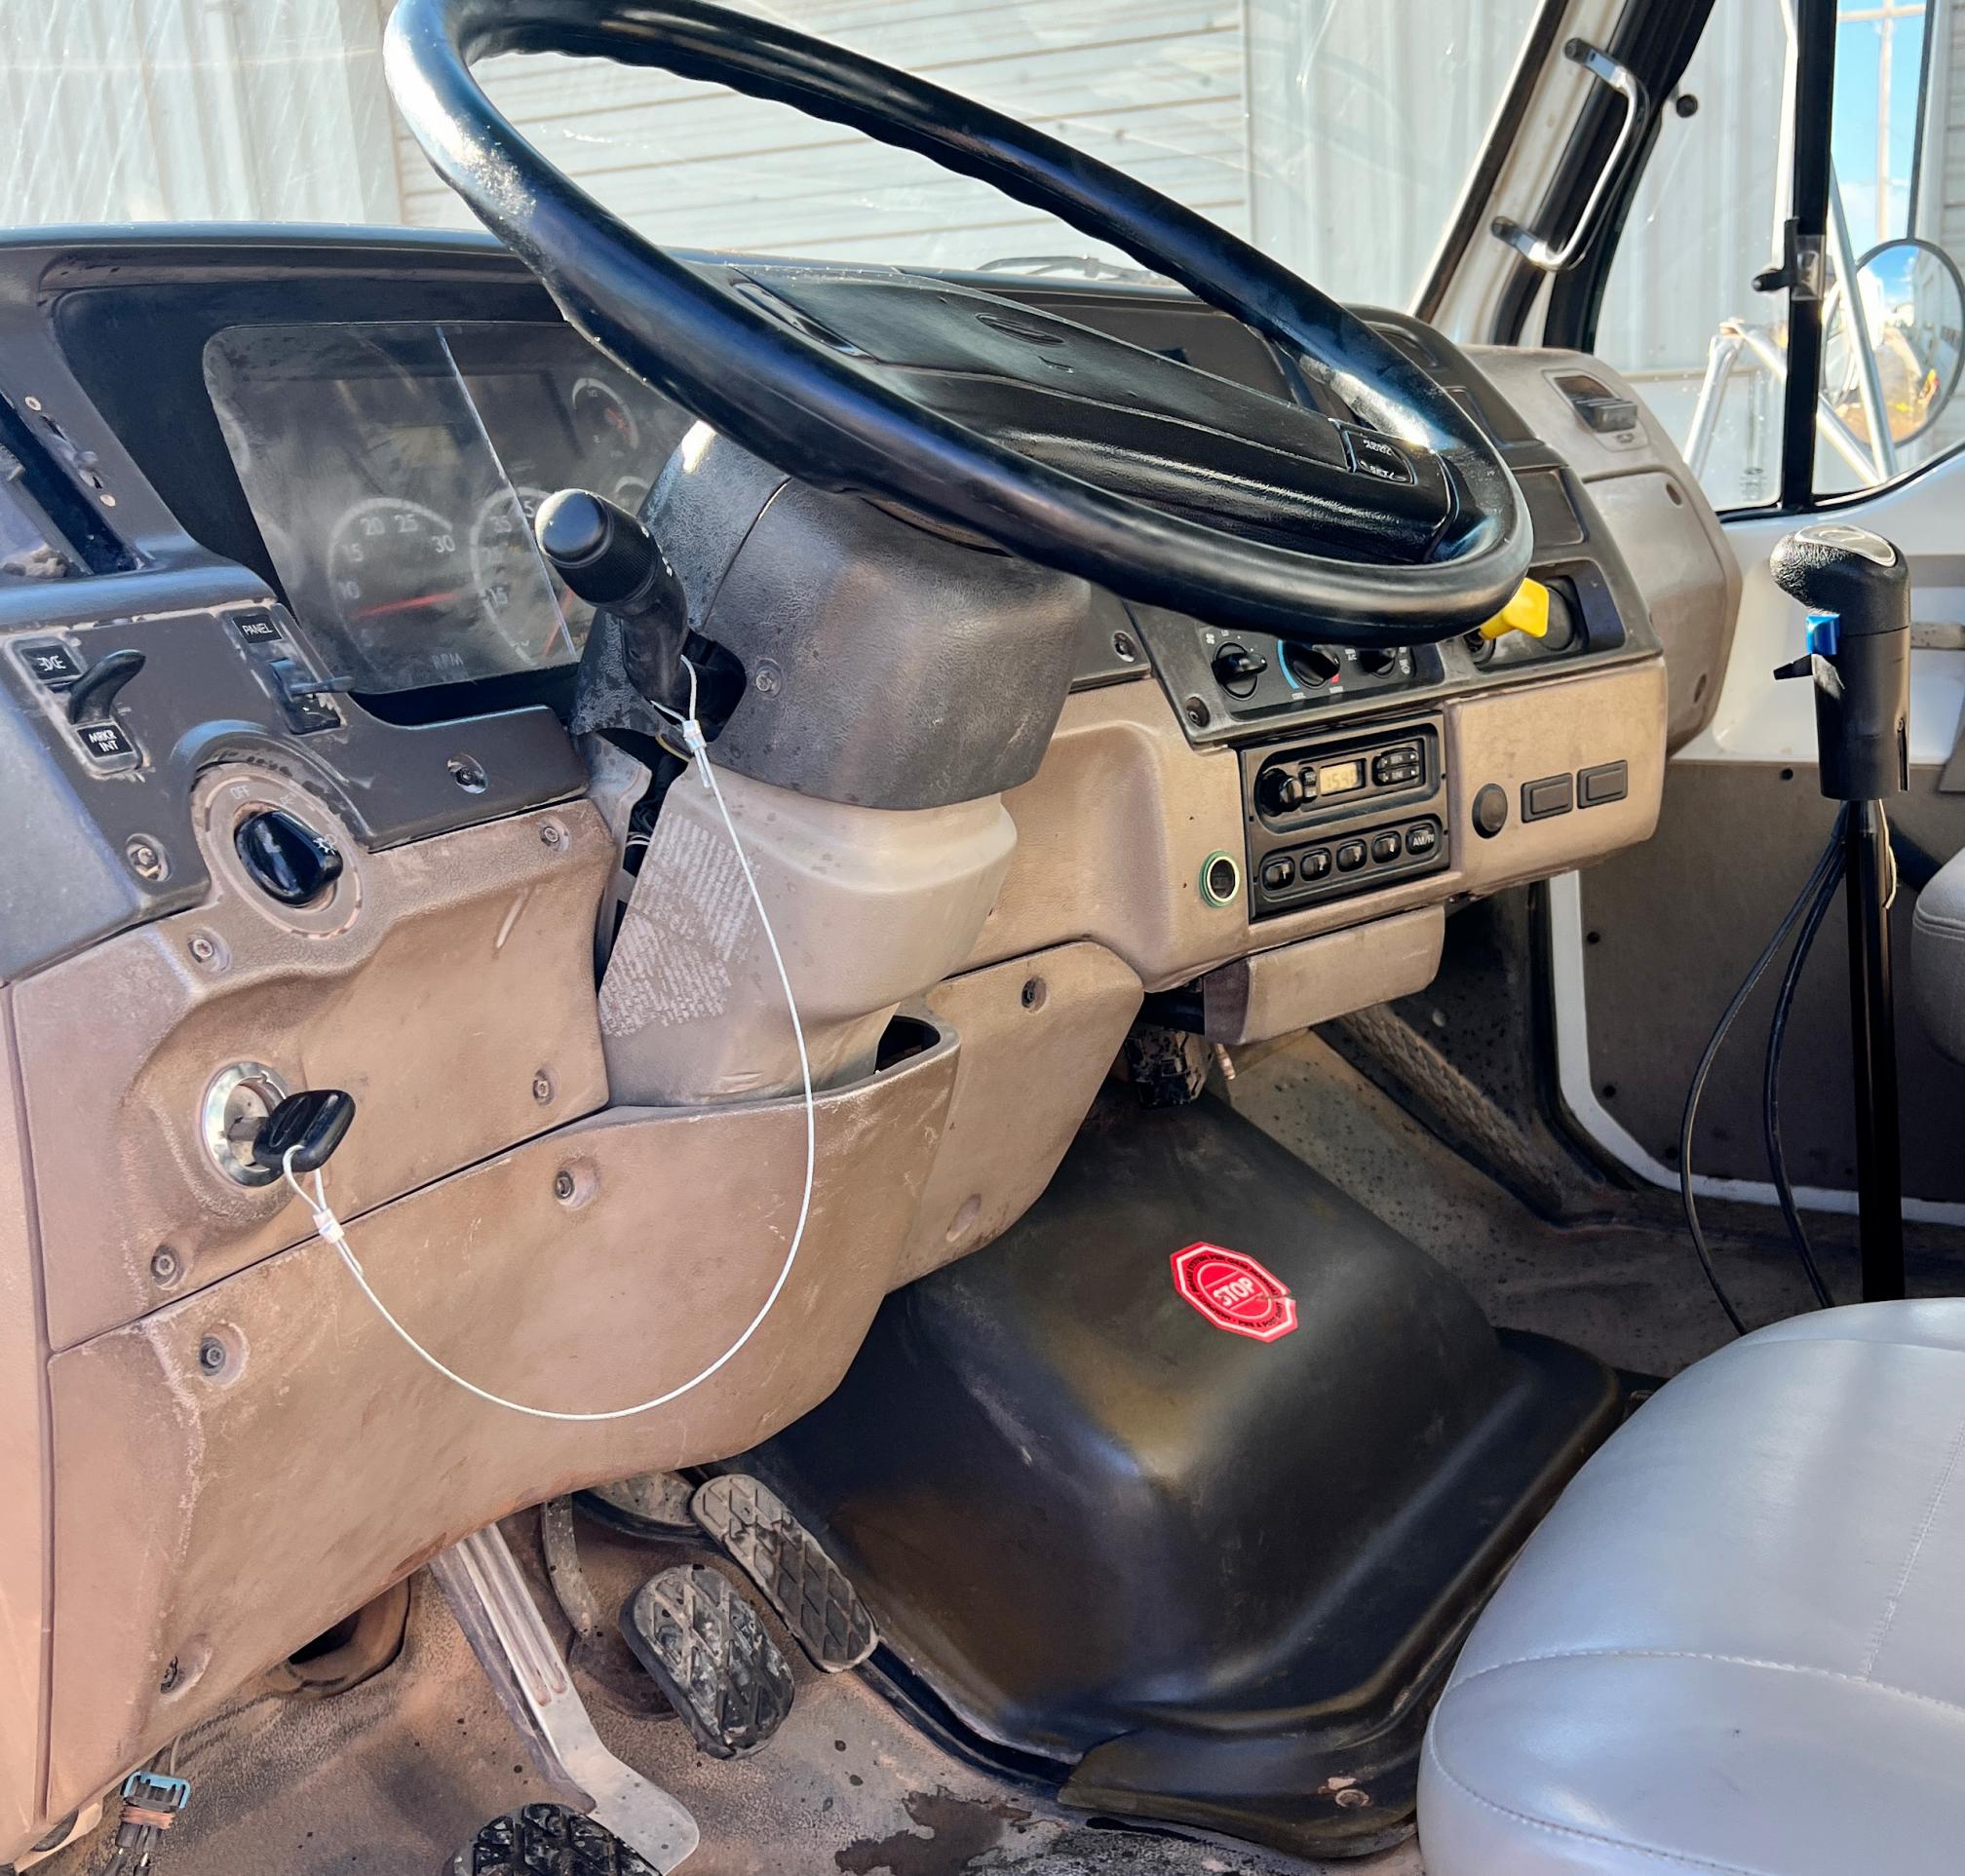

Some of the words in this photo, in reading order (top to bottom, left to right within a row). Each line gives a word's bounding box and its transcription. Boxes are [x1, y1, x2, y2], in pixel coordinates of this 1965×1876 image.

[361, 517, 386, 536] 20
[395, 514, 419, 533] 25
[432, 534, 456, 554] 30
[242, 623, 274, 636] PANEL
[431, 652, 464, 670] RPM
[88, 729, 118, 744] MRKR
[97, 740, 119, 752] INT
[230, 785, 250, 799] OFF
[1213, 1277, 1255, 1307] STOP
